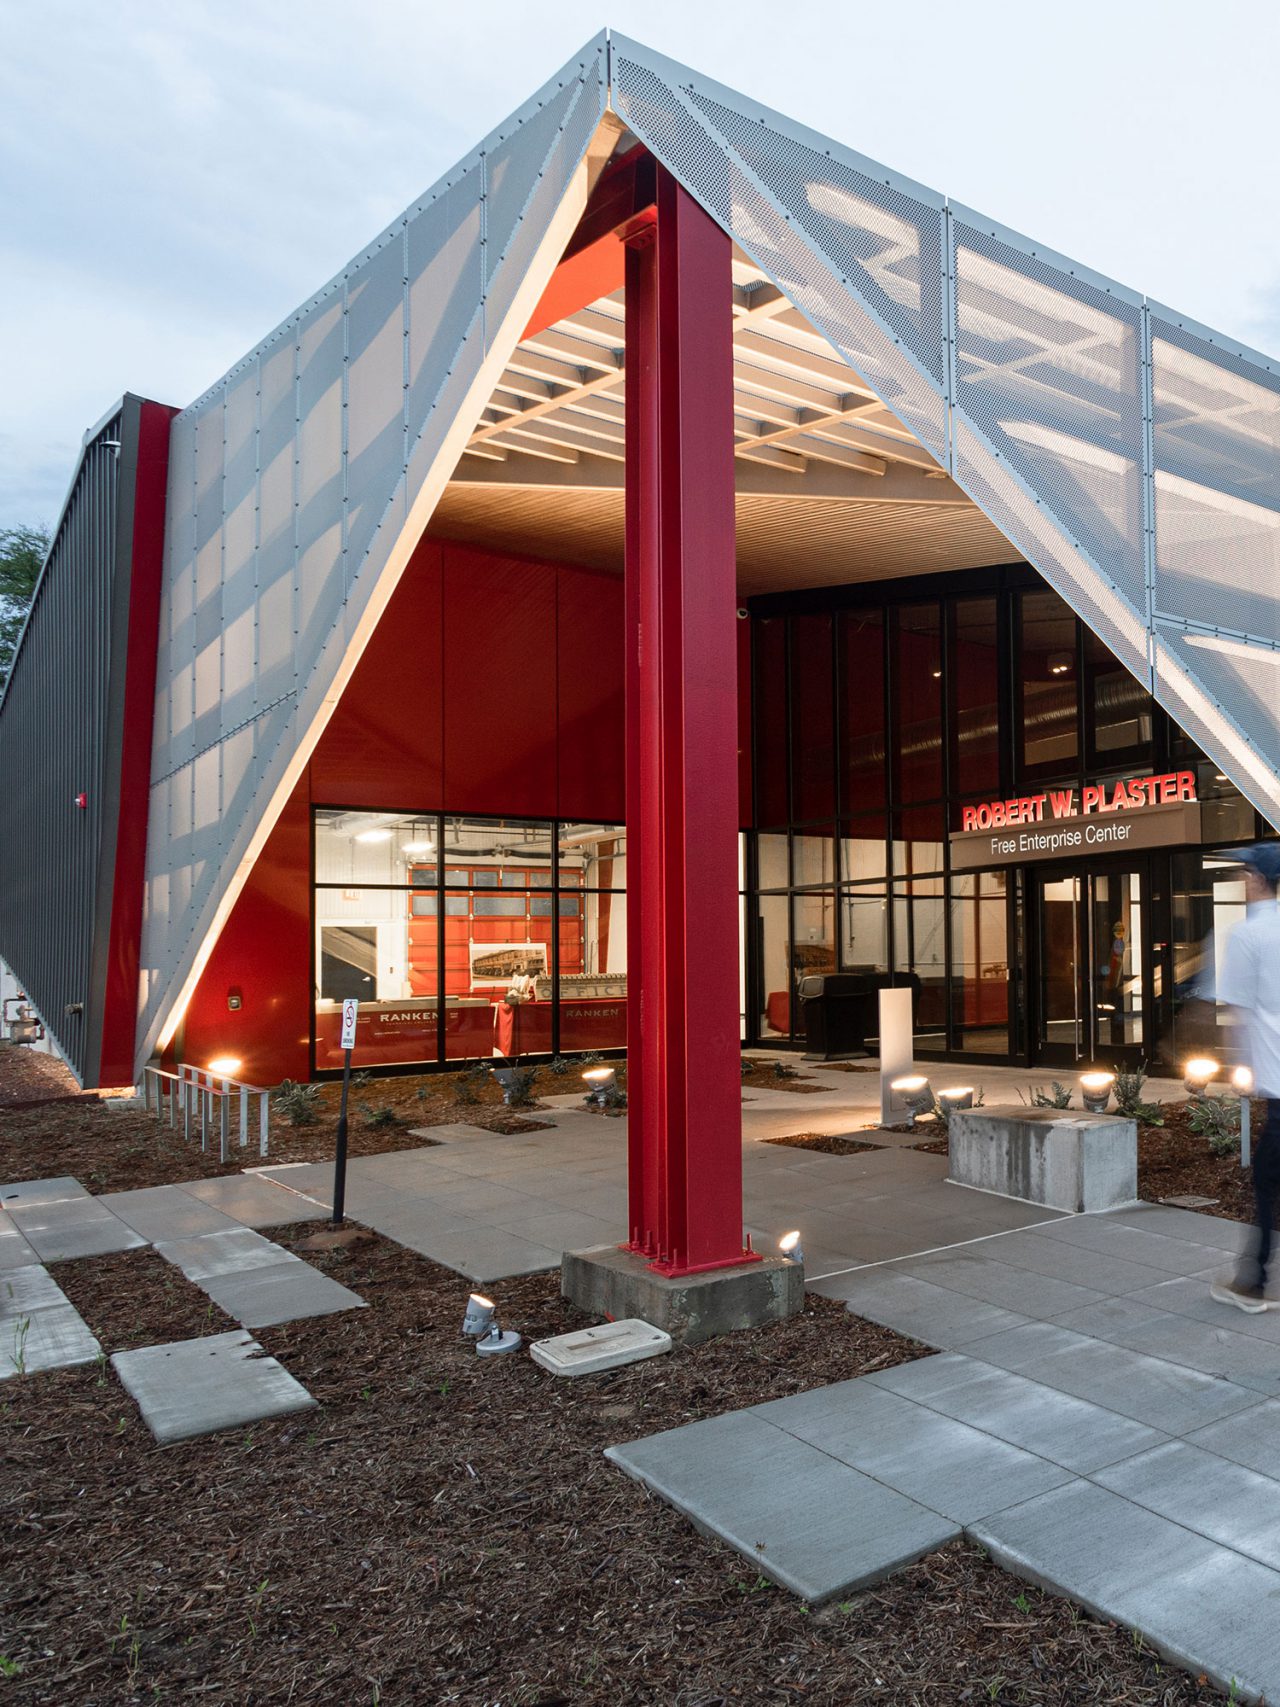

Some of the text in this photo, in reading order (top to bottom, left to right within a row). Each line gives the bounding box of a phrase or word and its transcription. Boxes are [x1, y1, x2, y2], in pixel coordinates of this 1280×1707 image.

[963, 771, 1197, 831] ROBERT W. PLASTER
[991, 823, 1131, 854] Free Enterprise Center
[566, 1009, 618, 1017] RANKEN
